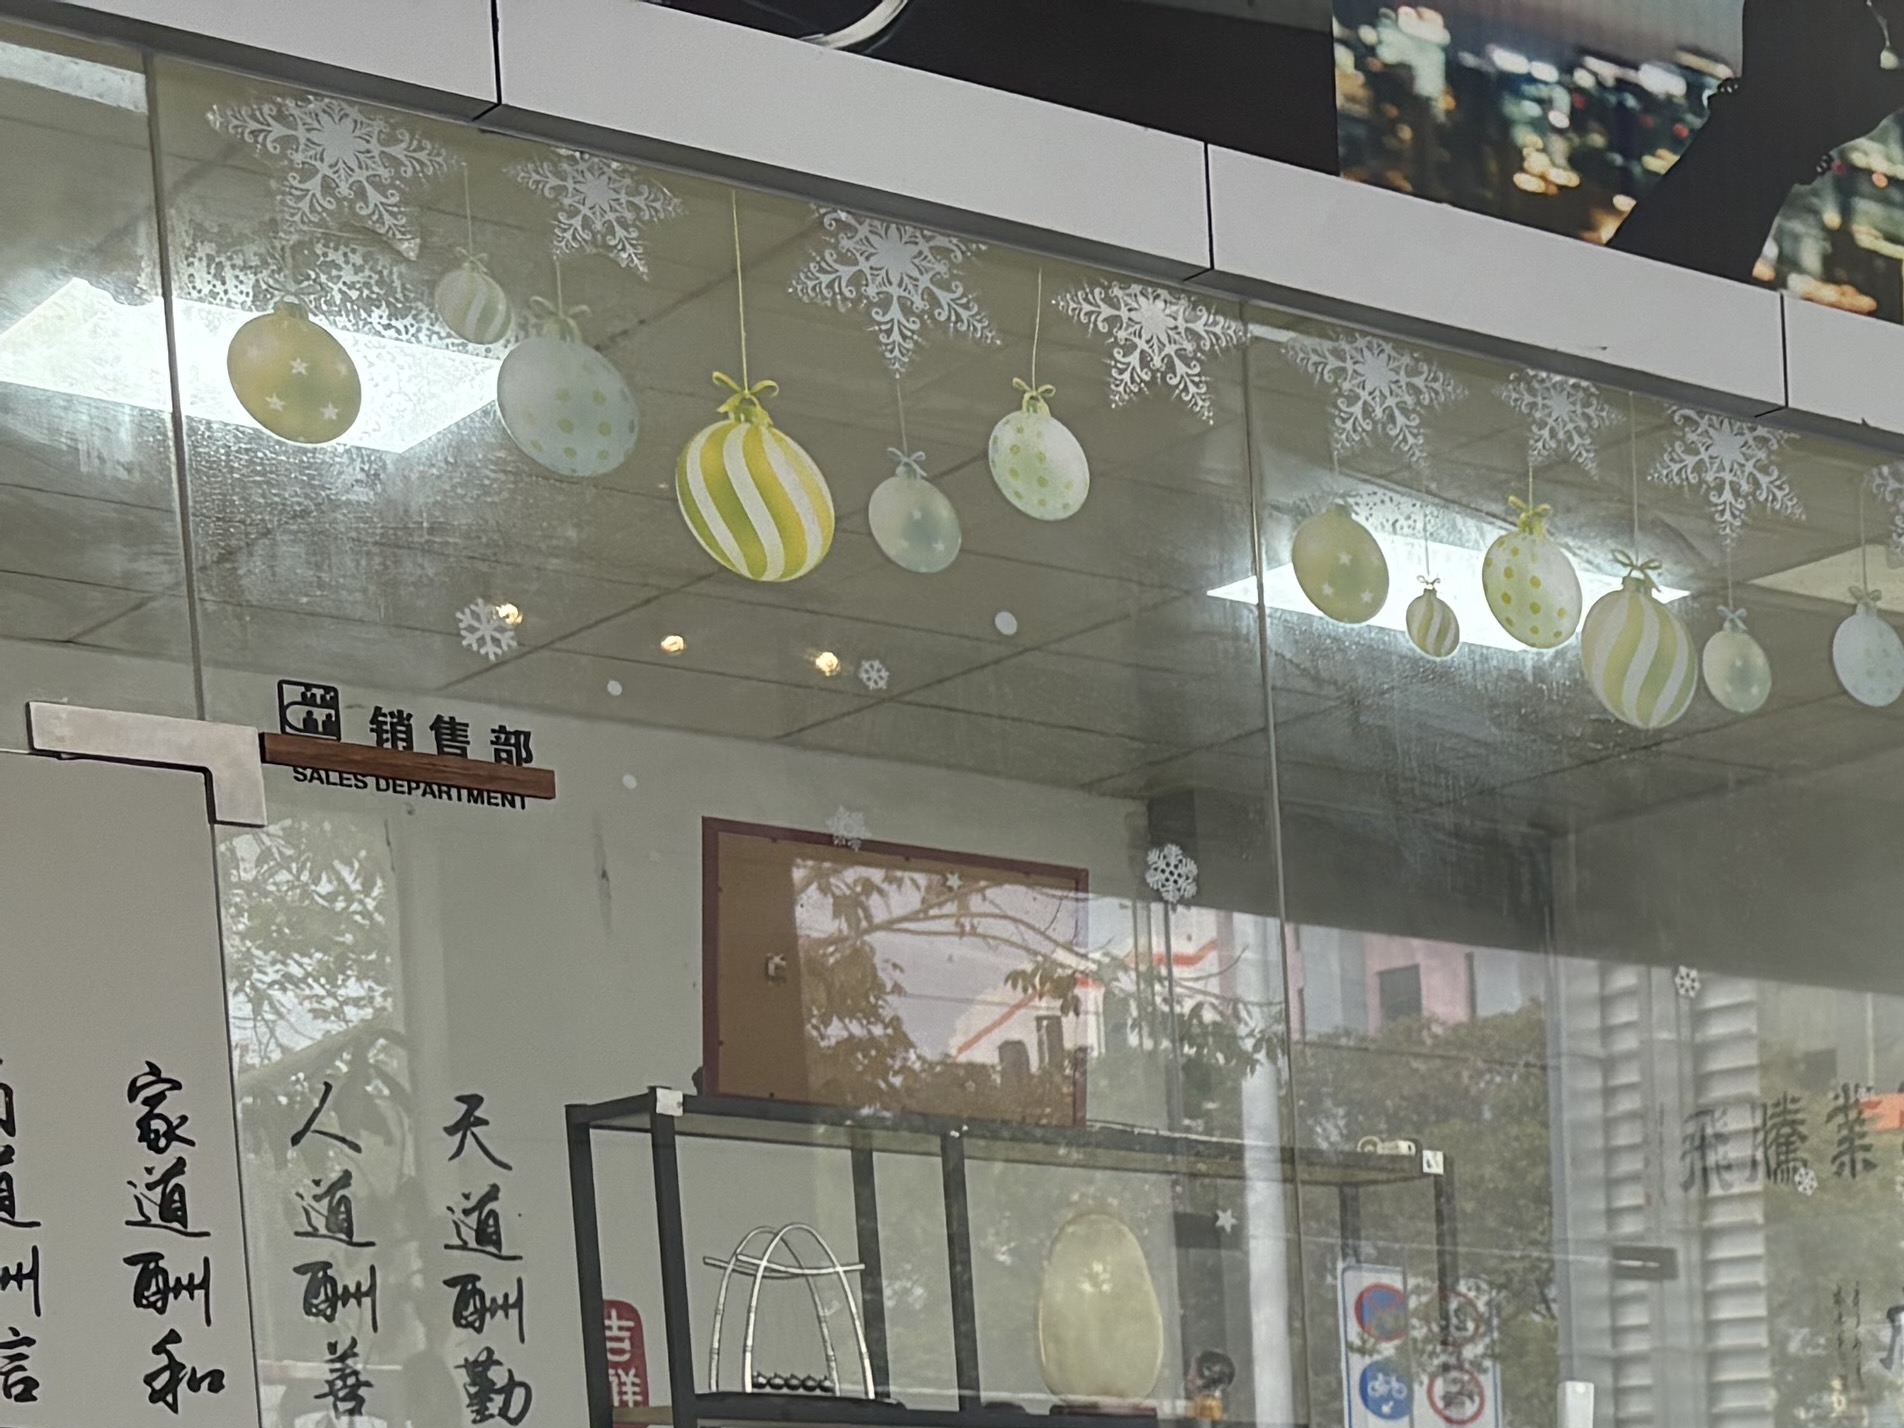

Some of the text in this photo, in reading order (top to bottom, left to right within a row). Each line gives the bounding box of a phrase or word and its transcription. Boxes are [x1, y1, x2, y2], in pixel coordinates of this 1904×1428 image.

[293, 766, 527, 810] SALES DEPARTMENT
[370, 706, 533, 767] 销售部
[122, 1060, 226, 1415] 家道酬和
[291, 1081, 378, 1418] 人道酬善
[443, 1093, 533, 1426] 天道酬勤
